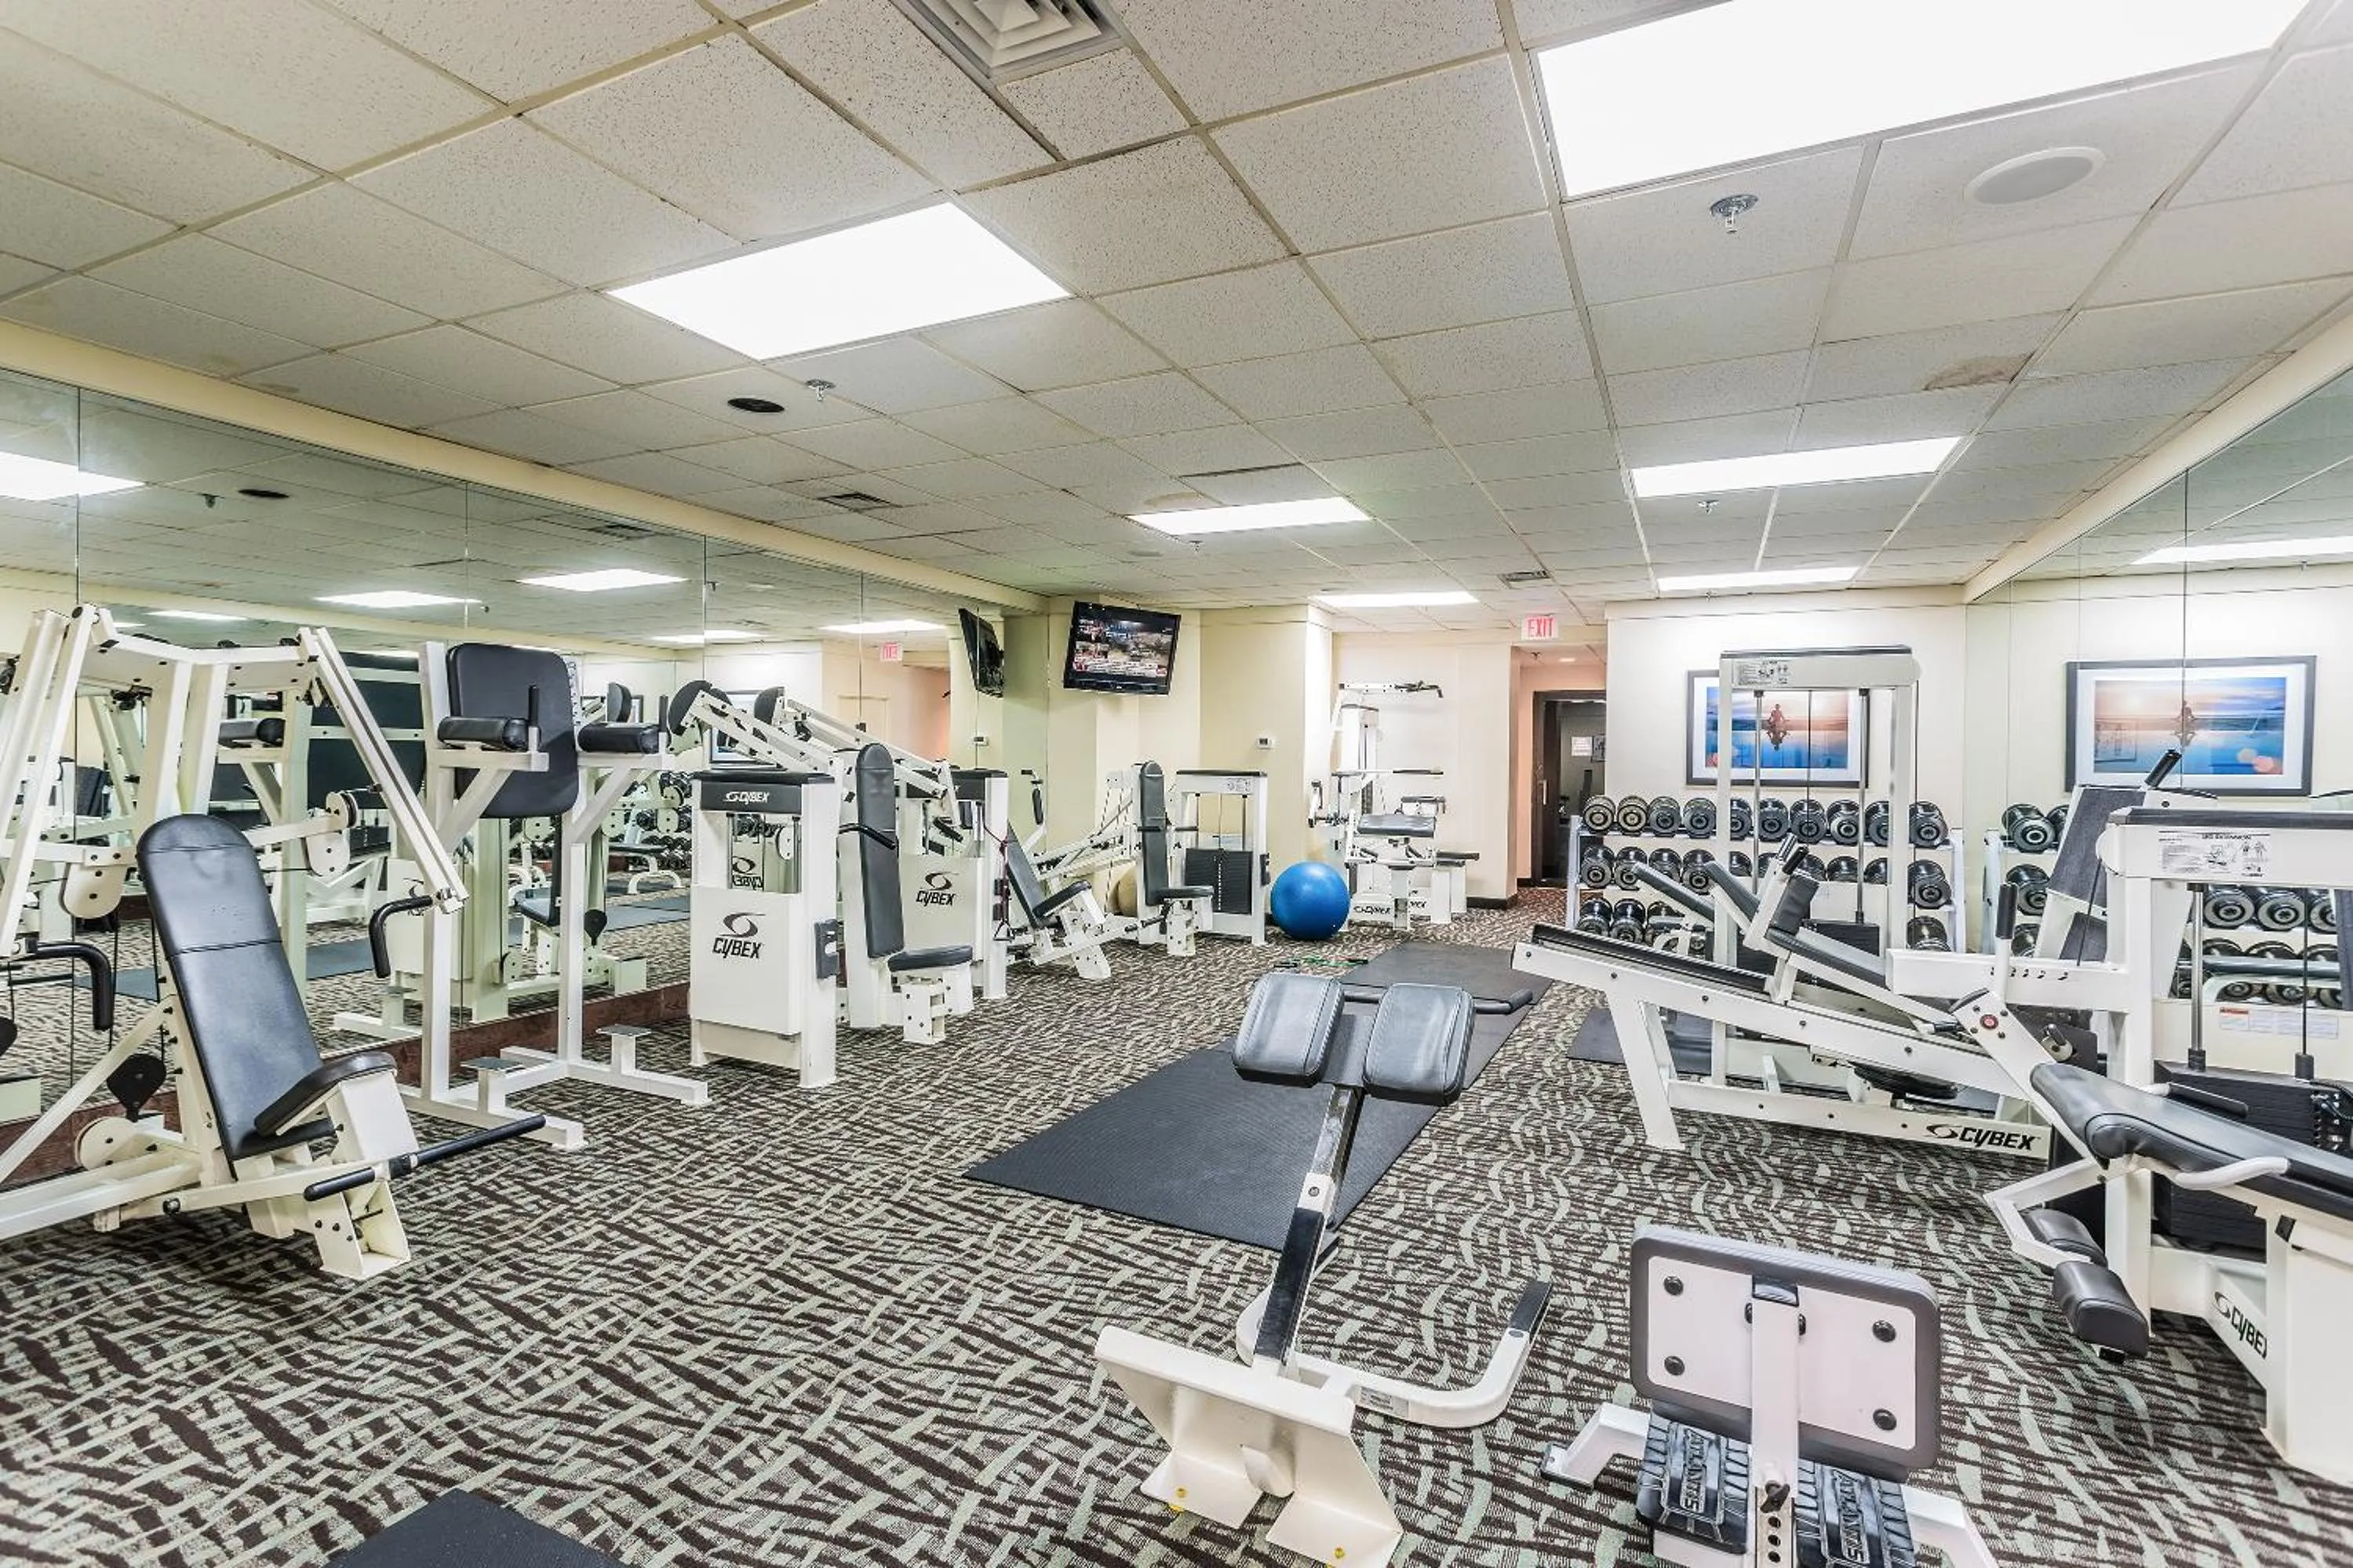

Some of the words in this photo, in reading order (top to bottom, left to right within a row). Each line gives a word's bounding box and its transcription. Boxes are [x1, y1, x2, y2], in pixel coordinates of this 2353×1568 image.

[1527, 618, 1553, 638] EXIT
[738, 791, 770, 805] CYBEX
[916, 890, 956, 907] CYBEX
[712, 937, 763, 959] CYBEX
[1959, 1126, 2038, 1151] CYBEX
